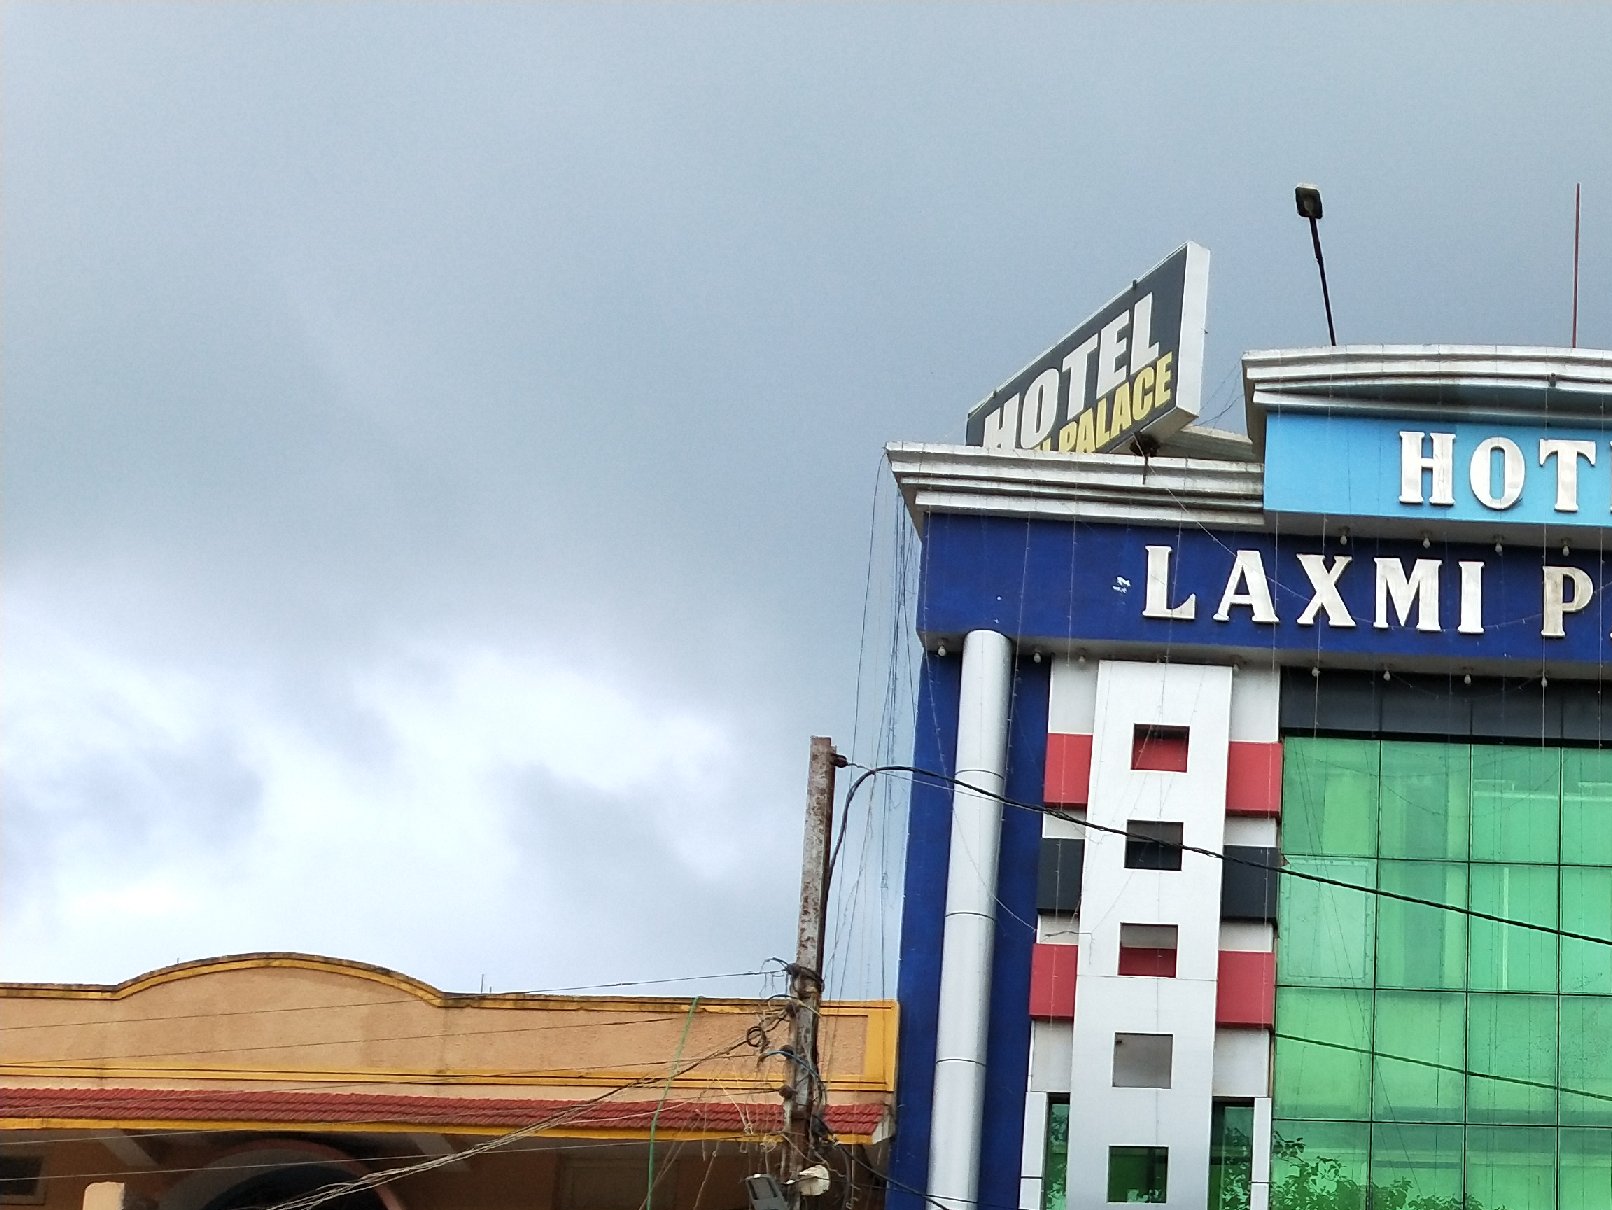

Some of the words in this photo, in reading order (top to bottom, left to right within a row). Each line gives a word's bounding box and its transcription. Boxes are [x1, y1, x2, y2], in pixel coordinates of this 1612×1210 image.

[983, 291, 1160, 450] HOTEL
[1059, 351, 1173, 453] PALACE
[1142, 544, 1487, 636] LAXMI
